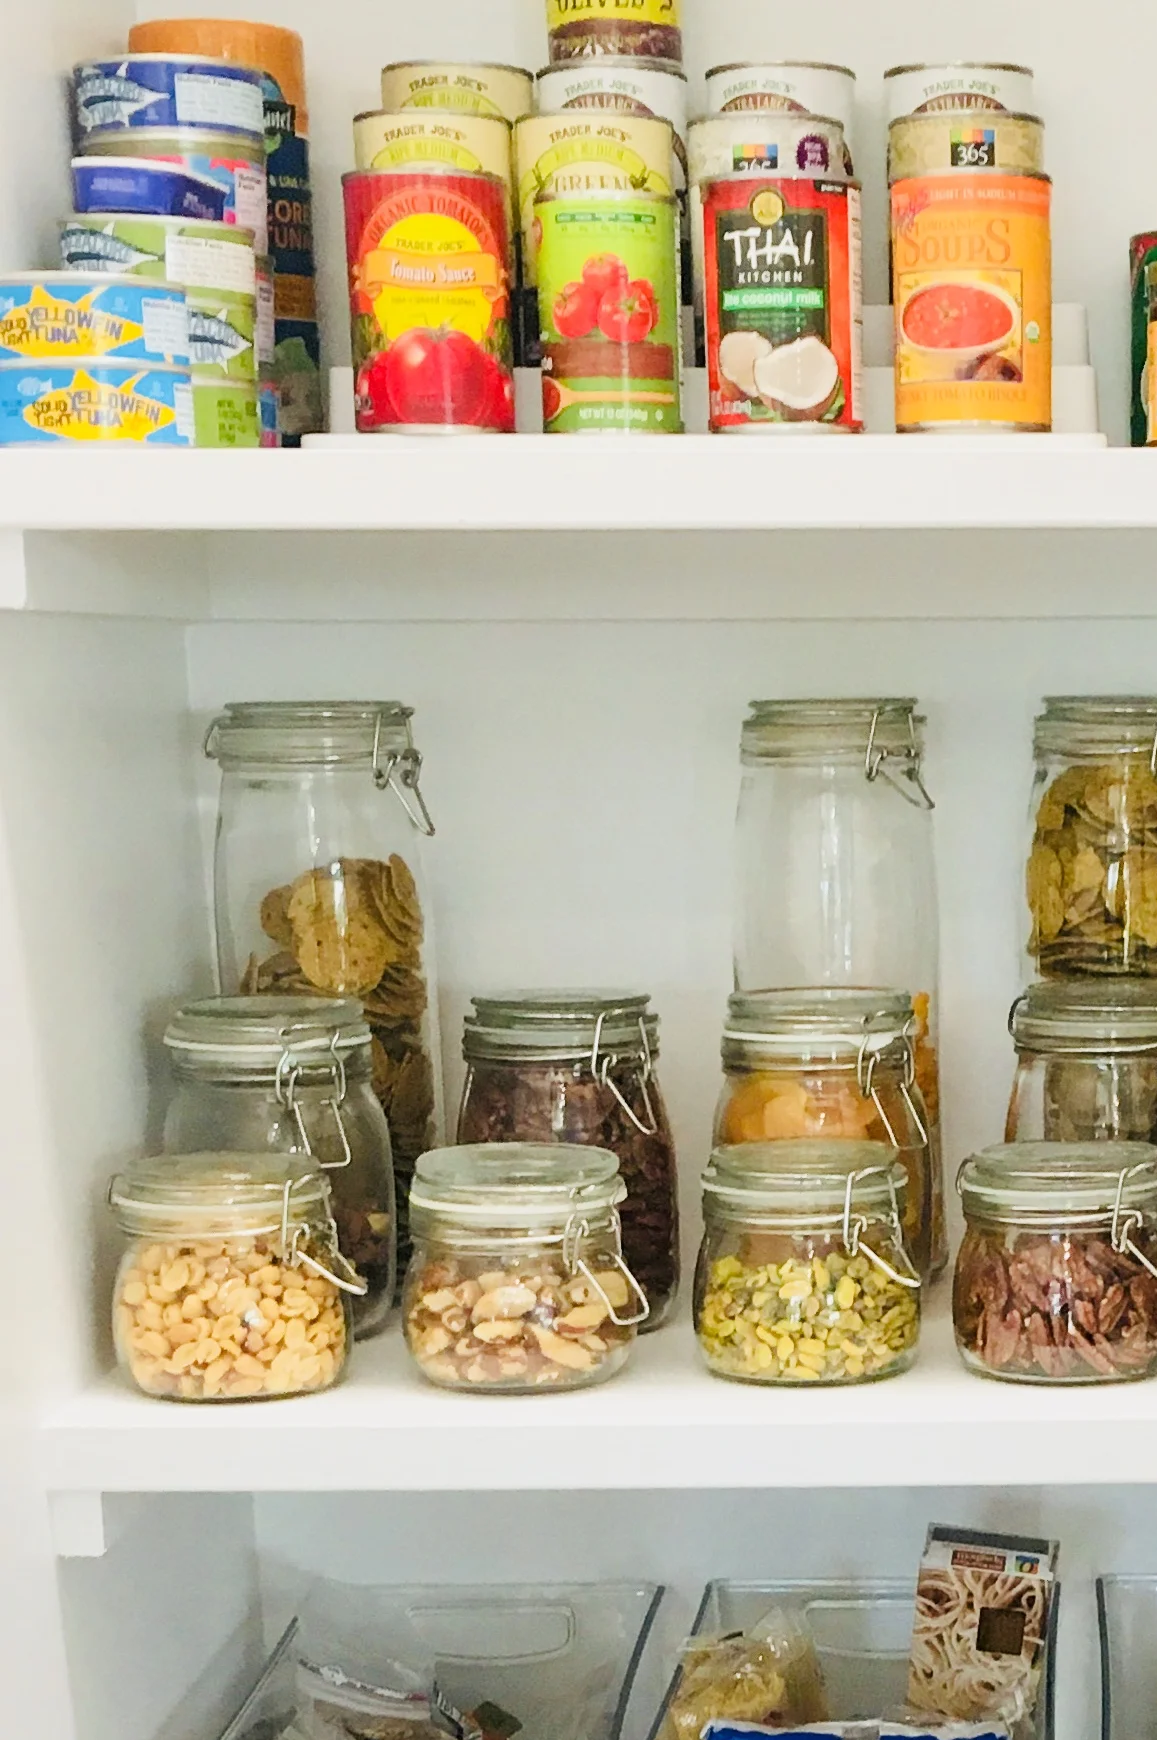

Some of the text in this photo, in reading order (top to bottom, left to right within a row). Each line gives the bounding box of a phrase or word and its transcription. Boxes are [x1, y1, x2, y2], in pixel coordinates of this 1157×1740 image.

[409, 75, 448, 92] TRADER
[564, 80, 604, 97] TRADER
[922, 79, 964, 97] TRADER
[384, 124, 425, 142] TRADER
[549, 125, 592, 144] TRADER
[957, 143, 989, 166] 365
[396, 238, 433, 251] TRADER
[723, 226, 813, 269] THAI
[901, 218, 1012, 267] SOUPS
[391, 259, 476, 284] Tomato Sauce
[738, 271, 803, 284] KITCHEN
[797, 289, 821, 305] milk
[32, 399, 68, 413] SOLID
[68, 390, 161, 426] YELLOWFIN
